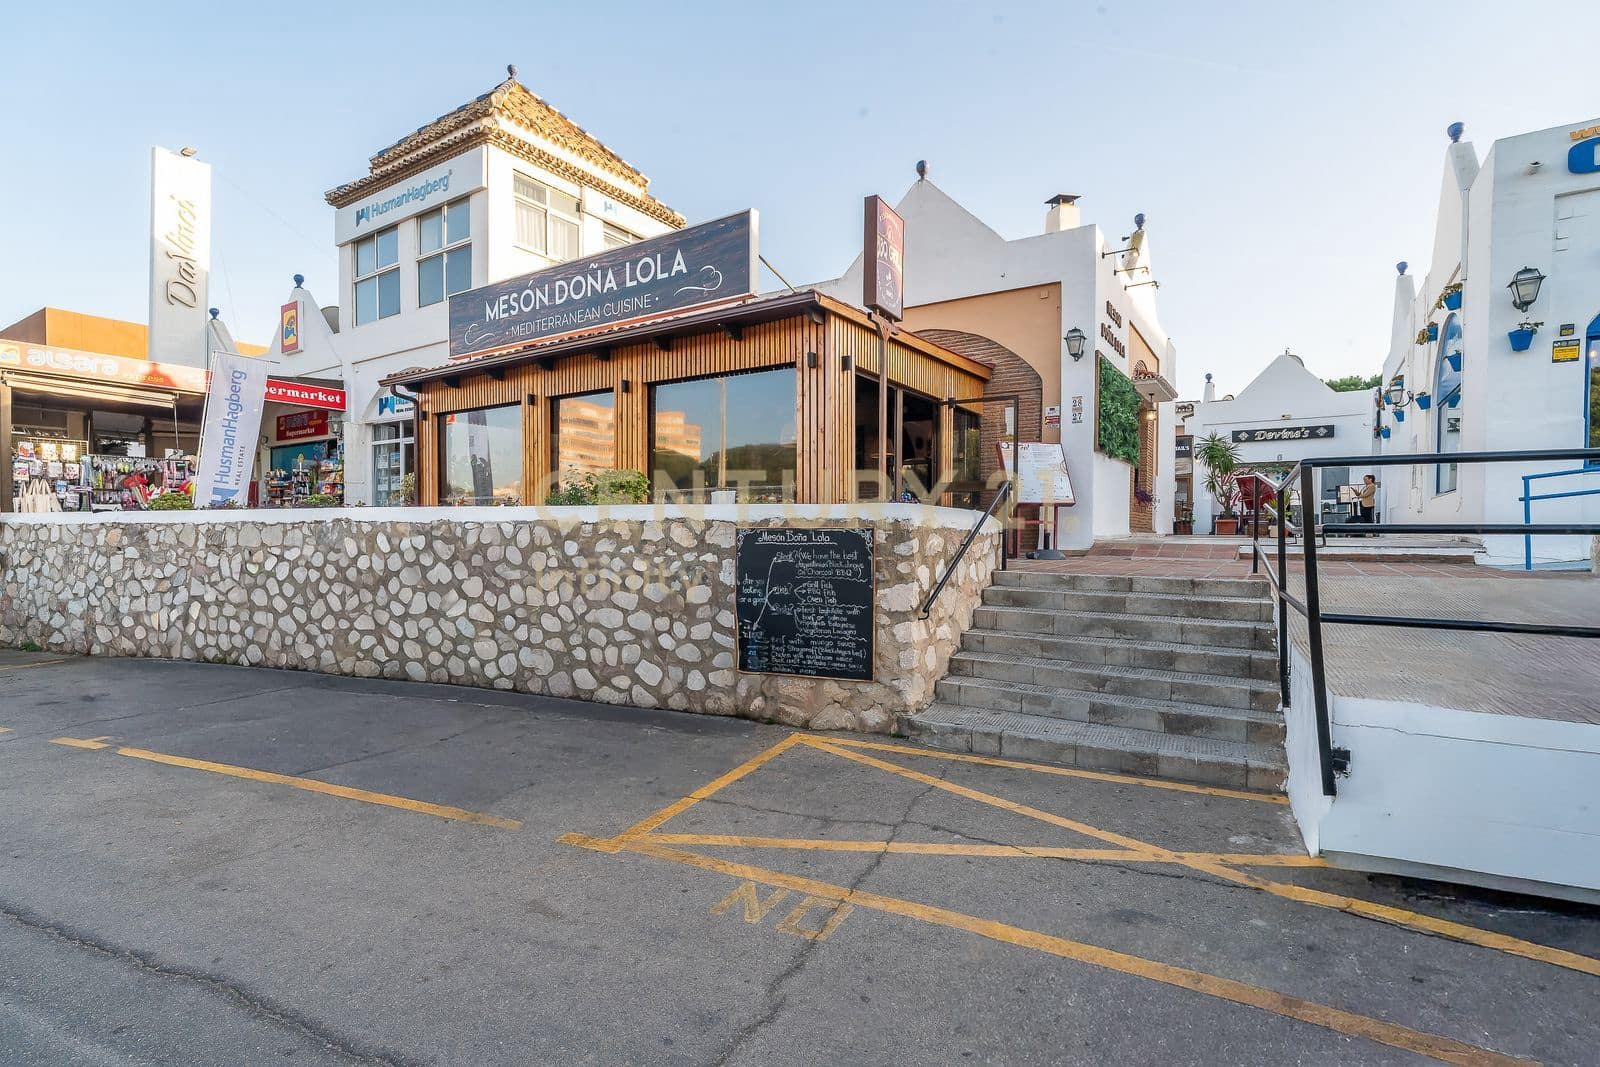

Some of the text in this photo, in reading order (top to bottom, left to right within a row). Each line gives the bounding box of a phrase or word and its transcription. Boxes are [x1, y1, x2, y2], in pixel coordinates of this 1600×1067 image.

[372, 175, 449, 217] HusmanHagberg
[485, 249, 688, 322] MESÓN DOÑA LOLA
[511, 294, 652, 337] MEDITERRANEAN CUISINE
[27, 348, 119, 376] alsara
[213, 369, 247, 484] HusmanHagberg
[812, 531, 830, 542] Lola
